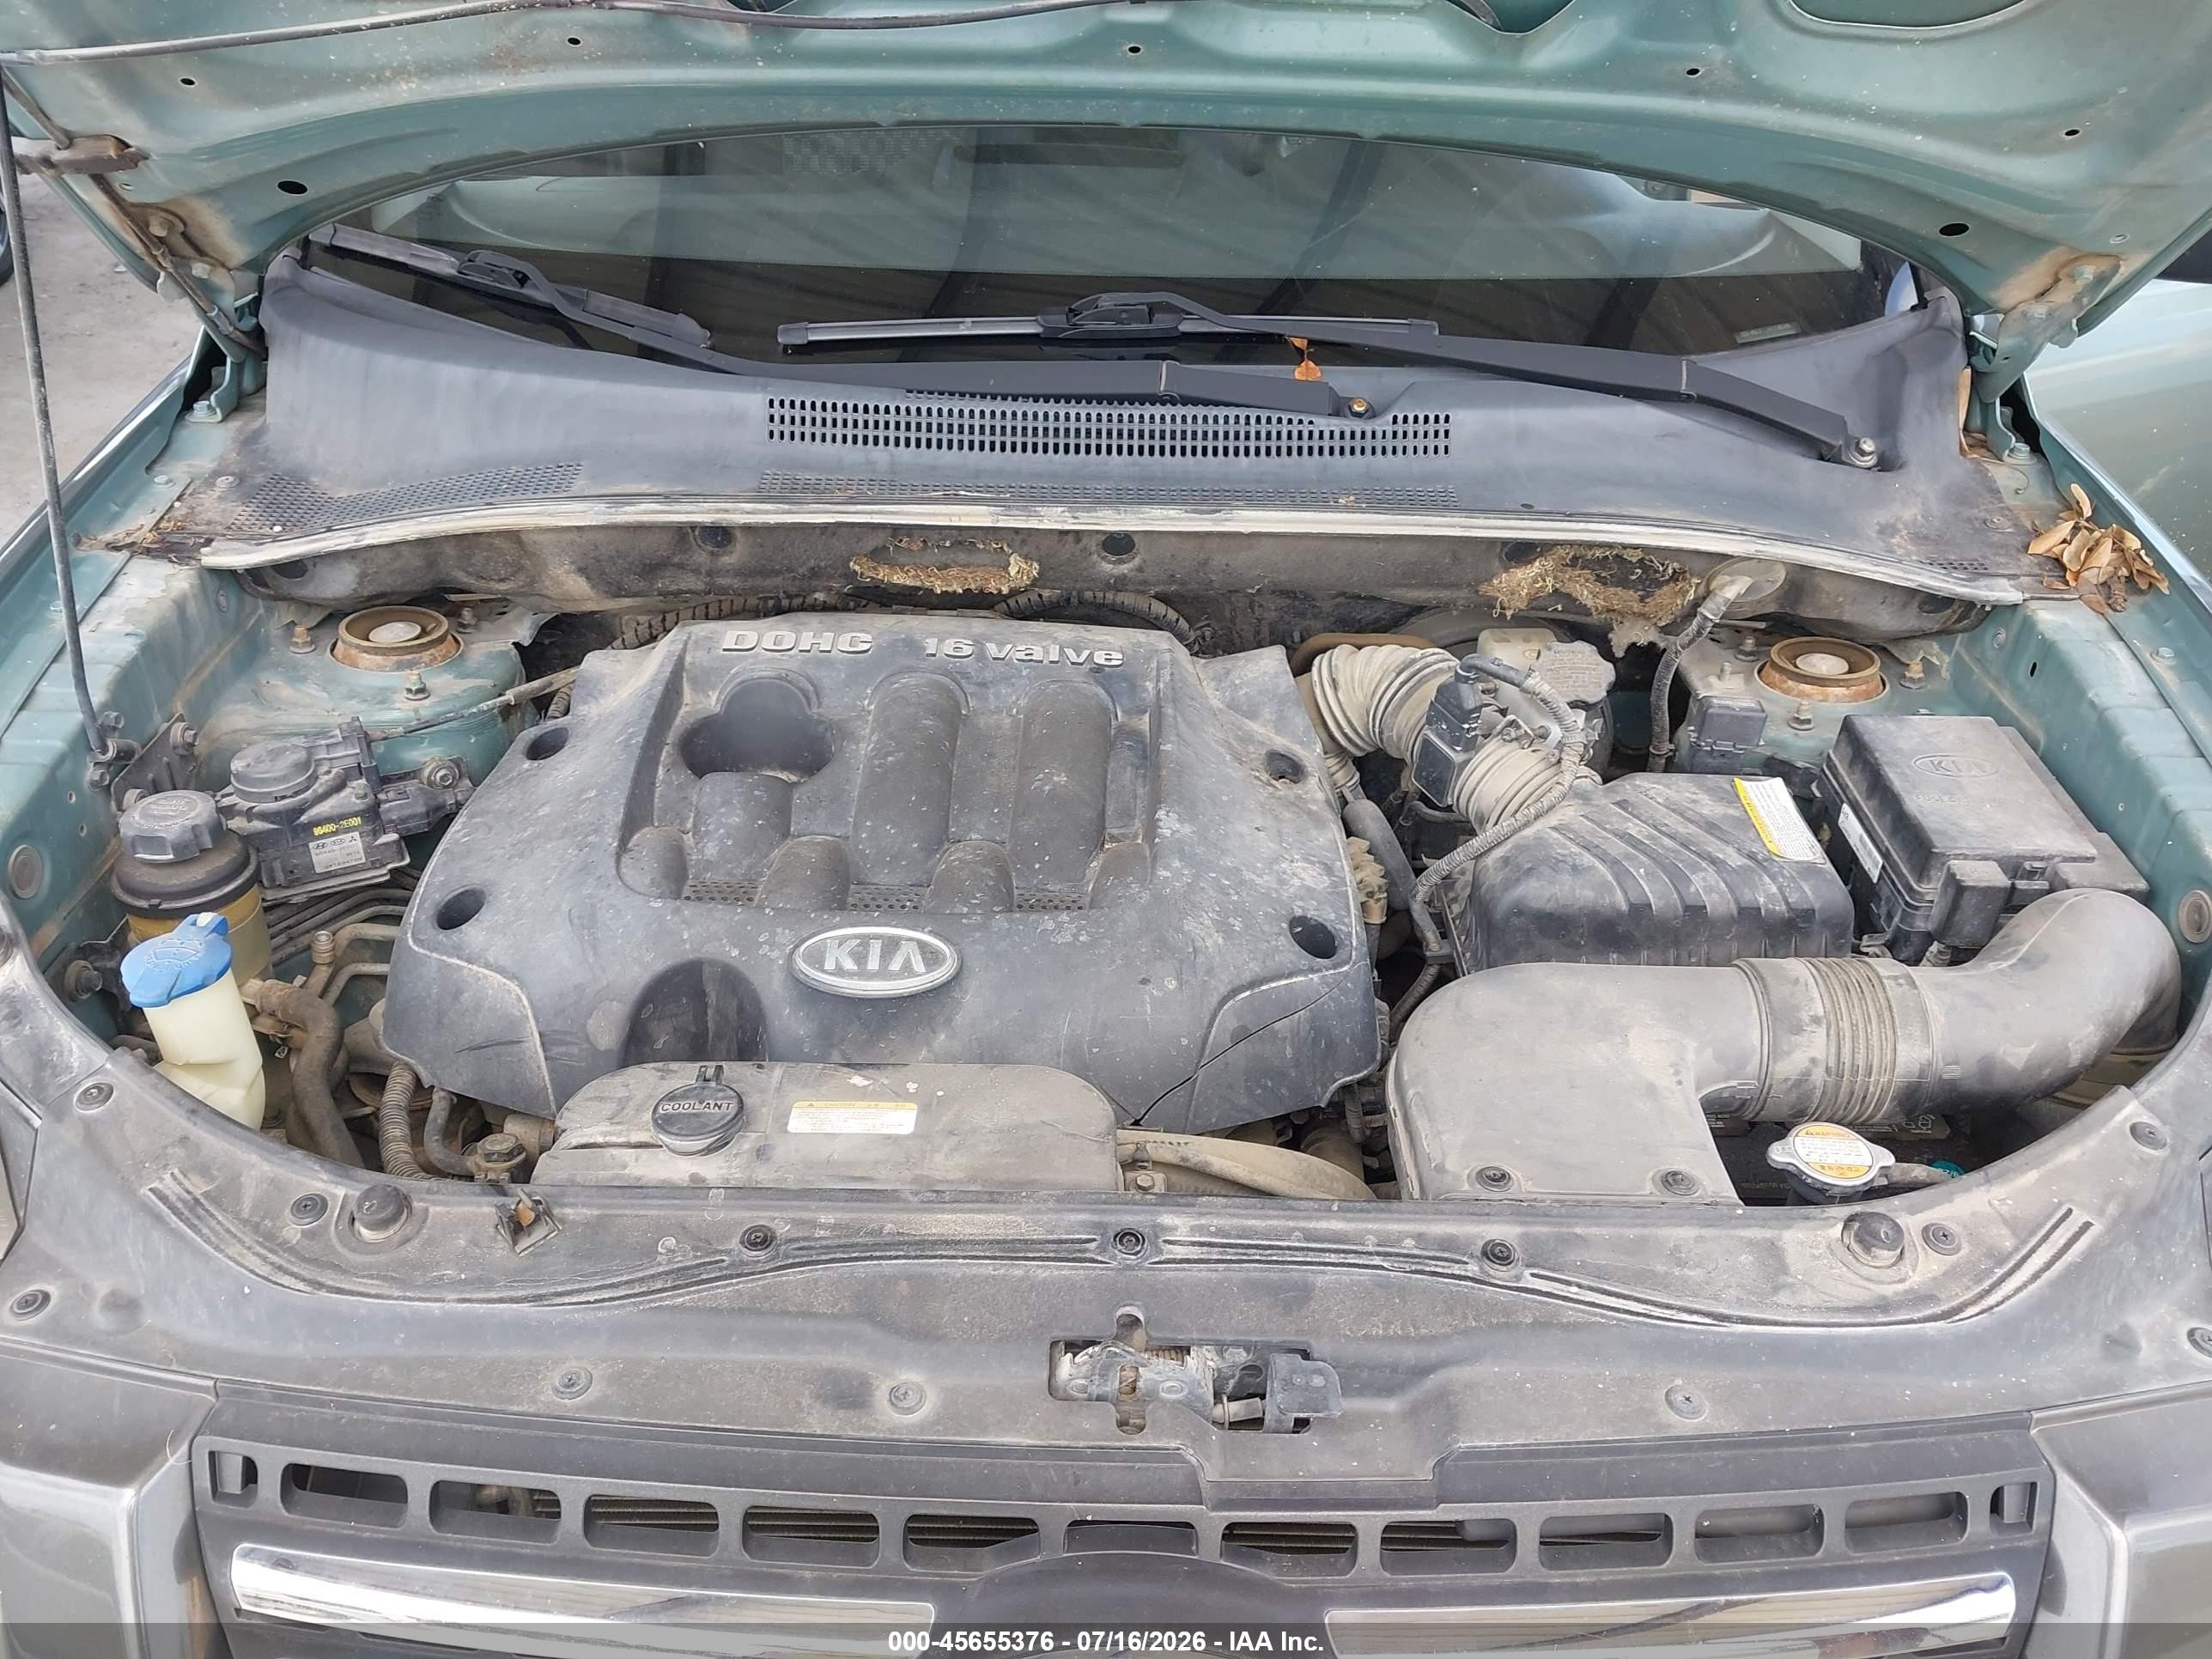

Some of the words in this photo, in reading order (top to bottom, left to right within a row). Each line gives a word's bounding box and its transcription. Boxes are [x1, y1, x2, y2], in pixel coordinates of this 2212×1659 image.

[722, 629, 873, 654] DOHC
[925, 637, 975, 659] 16
[983, 638, 1125, 668] valve
[1929, 759, 1986, 774] KIA
[823, 939, 927, 974] KIA
[659, 1100, 734, 1113] COOLANT
